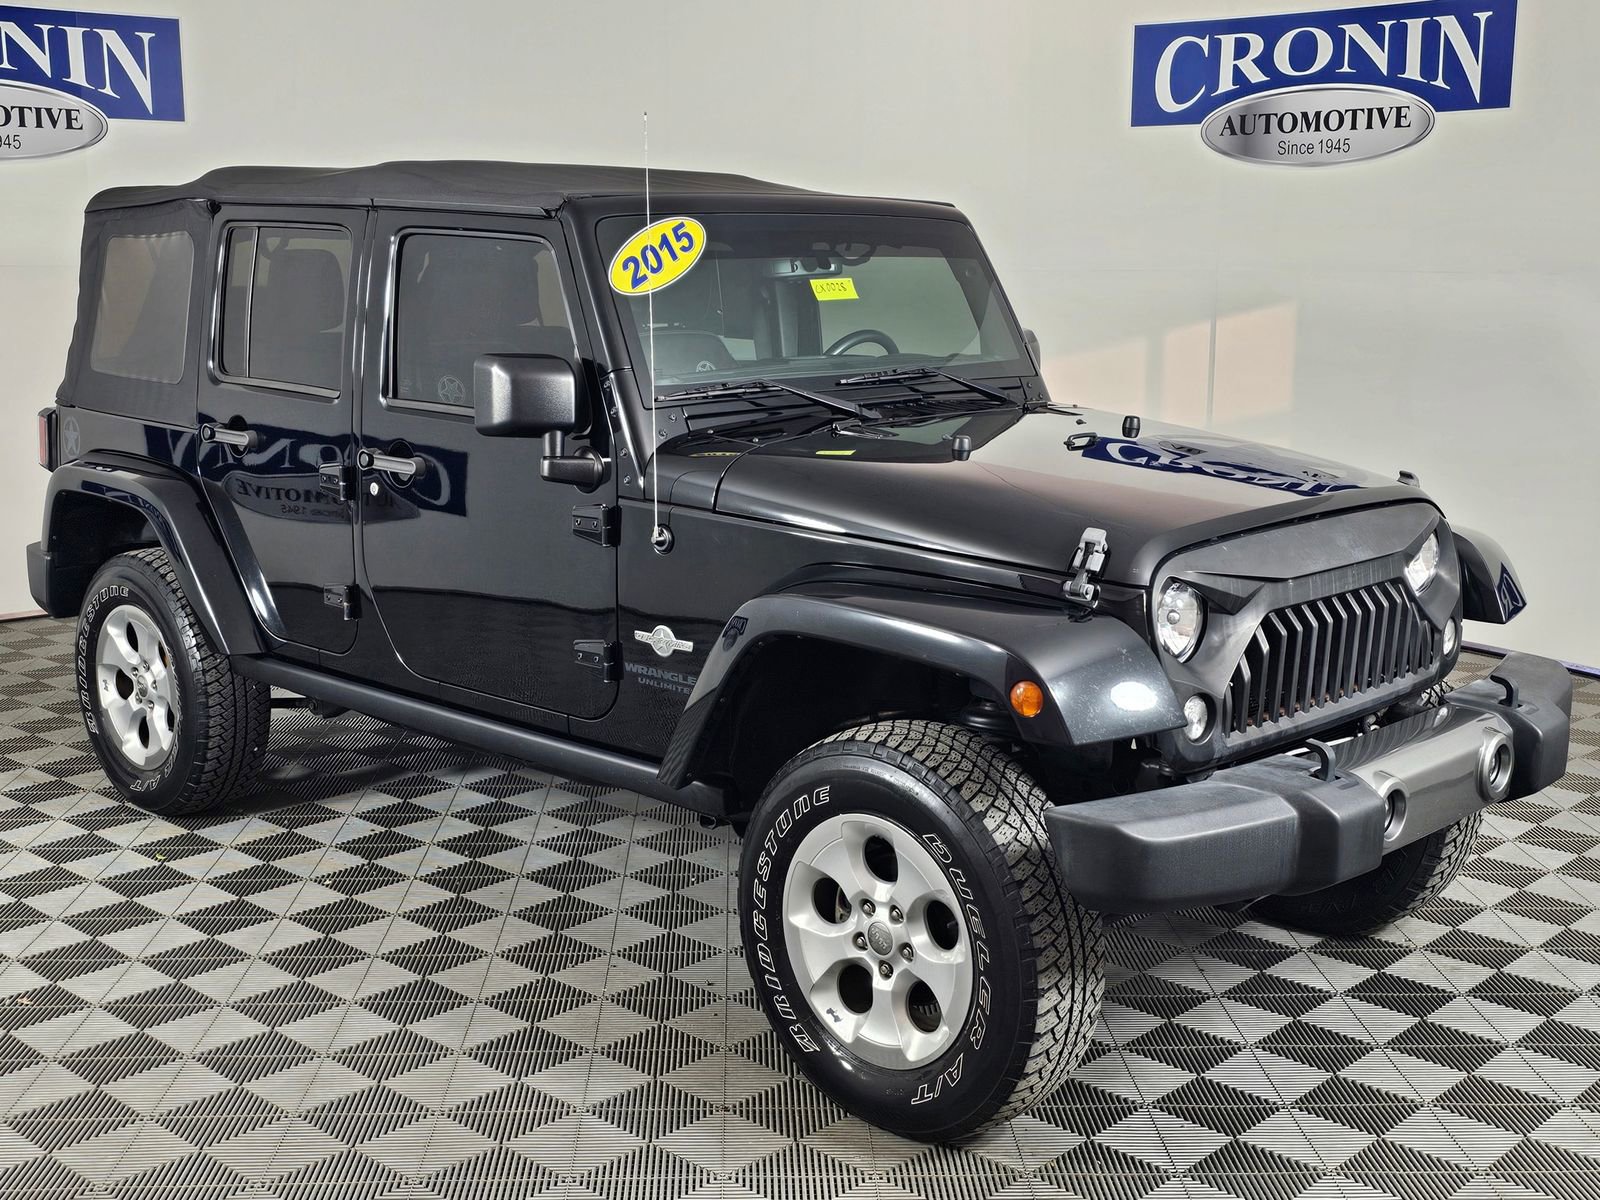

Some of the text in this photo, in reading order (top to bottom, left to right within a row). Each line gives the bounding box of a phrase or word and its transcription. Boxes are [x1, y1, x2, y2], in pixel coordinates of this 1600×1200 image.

[1154, 11, 1493, 113] CRONIN
[1219, 105, 1412, 137] AUTOMOTIVE
[0, 134, 22, 149] 45
[1277, 138, 1351, 156] Since 1945
[622, 221, 694, 289] 2015
[79, 585, 129, 735] BRIDGESTONE
[624, 662, 697, 686] WRANGLE
[638, 677, 693, 695] UNLIMITE
[130, 775, 161, 792] A/T
[752, 785, 831, 1053] BRIDGESTONE
[911, 832, 992, 1105] DUELER A/T
